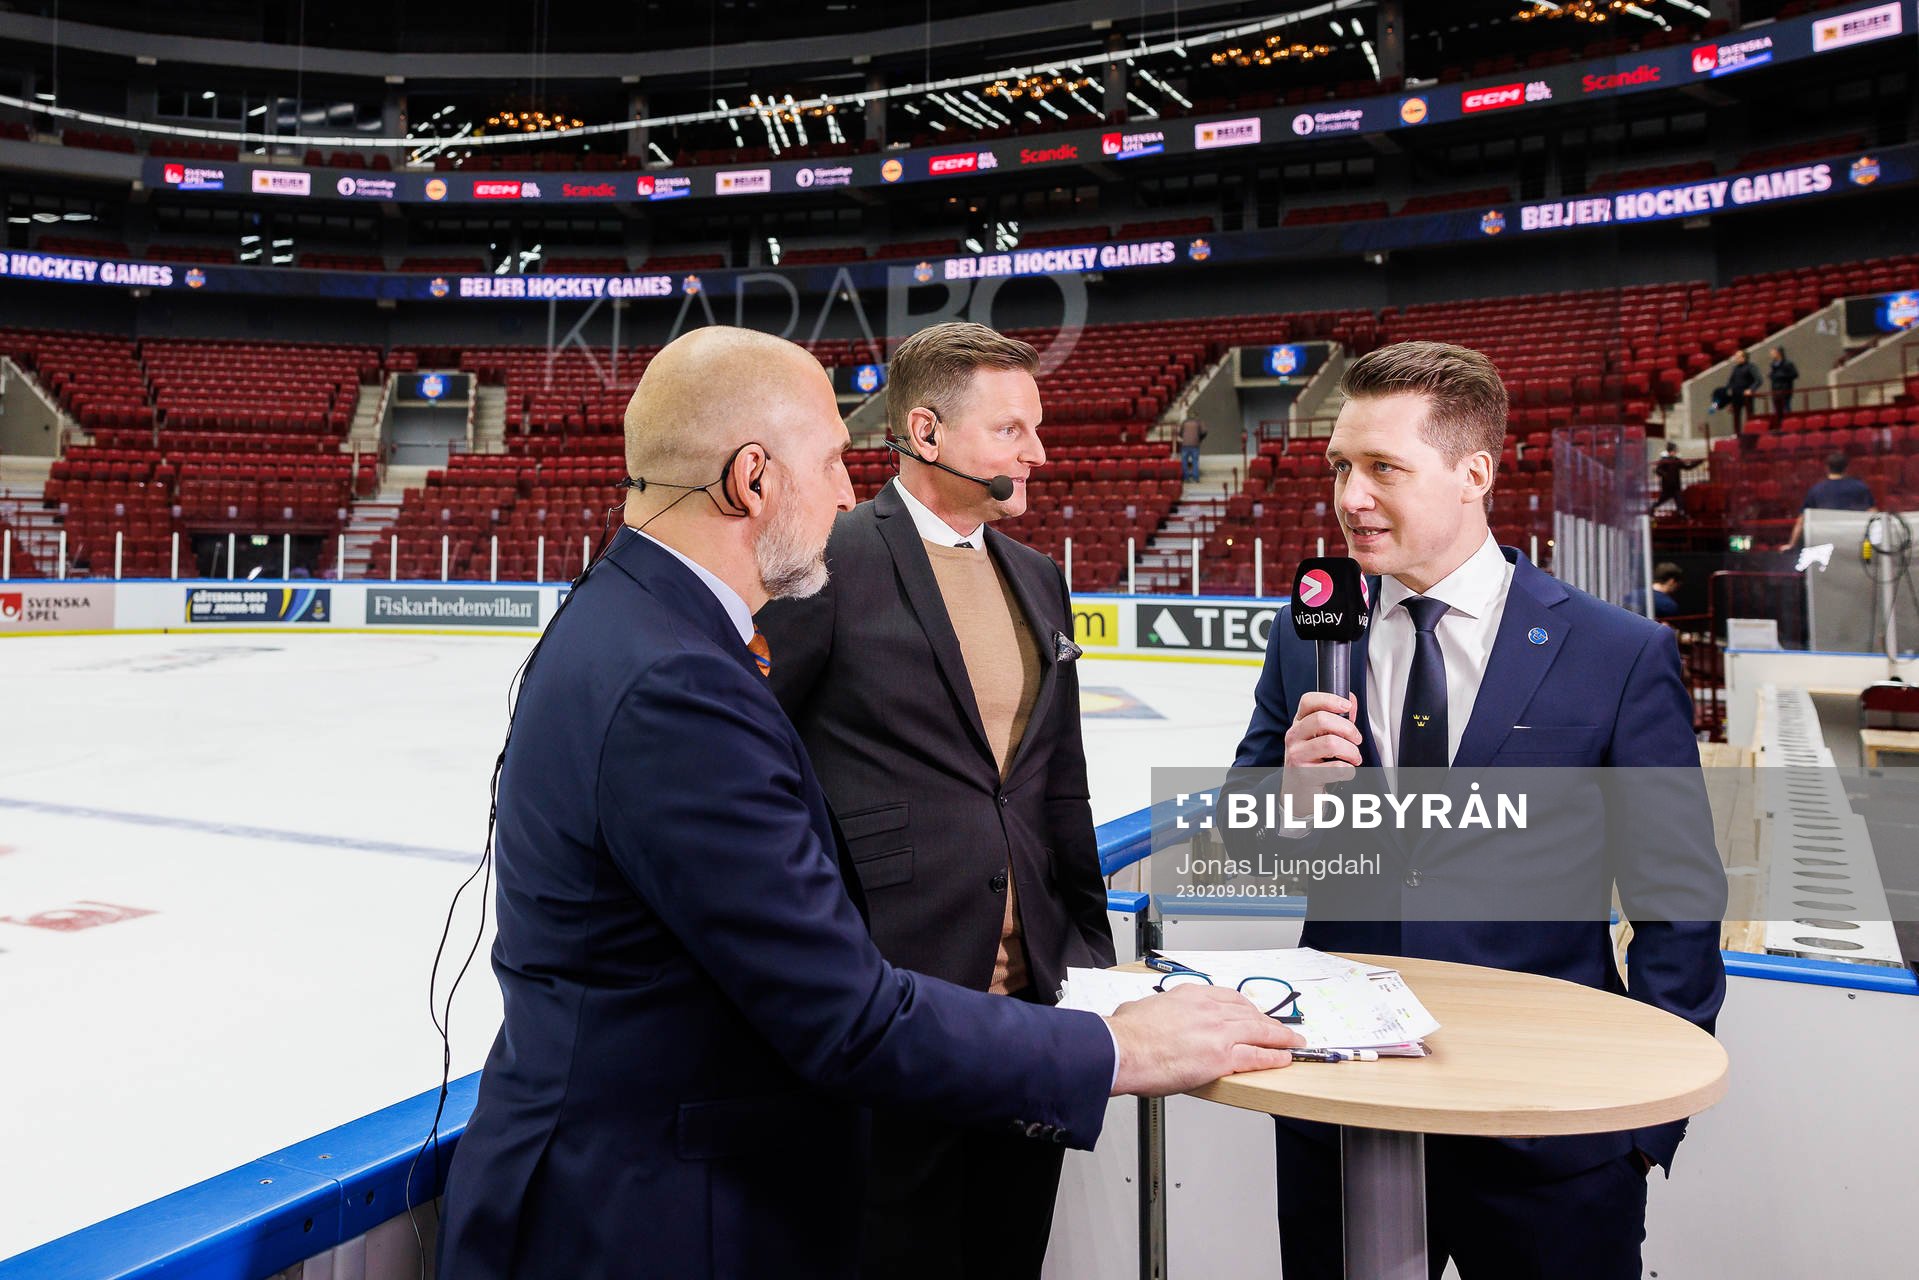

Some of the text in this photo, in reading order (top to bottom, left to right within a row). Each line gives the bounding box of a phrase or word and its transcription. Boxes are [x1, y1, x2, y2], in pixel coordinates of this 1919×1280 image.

[1582, 64, 1661, 92] Scandic
[1464, 88, 1521, 108] CCM
[931, 157, 975, 172] CCM
[1020, 144, 1078, 165] Scandic
[476, 184, 519, 195] CCM
[562, 184, 616, 198] Scandic
[1521, 164, 1832, 231] BEIJER HOCKEY GAMES
[11, 254, 98, 282] HOCKEY
[100, 262, 173, 287] GAMES
[944, 241, 1175, 280] BEIJER HOCKEY GAMES
[460, 276, 672, 298] BEIJER HOCKEY GAMES
[27, 597, 92, 609] SVENSKA
[374, 595, 533, 618] Fiskarhedenvillan
[27, 610, 60, 622] SPEL
[1295, 610, 1343, 627] viaplay
